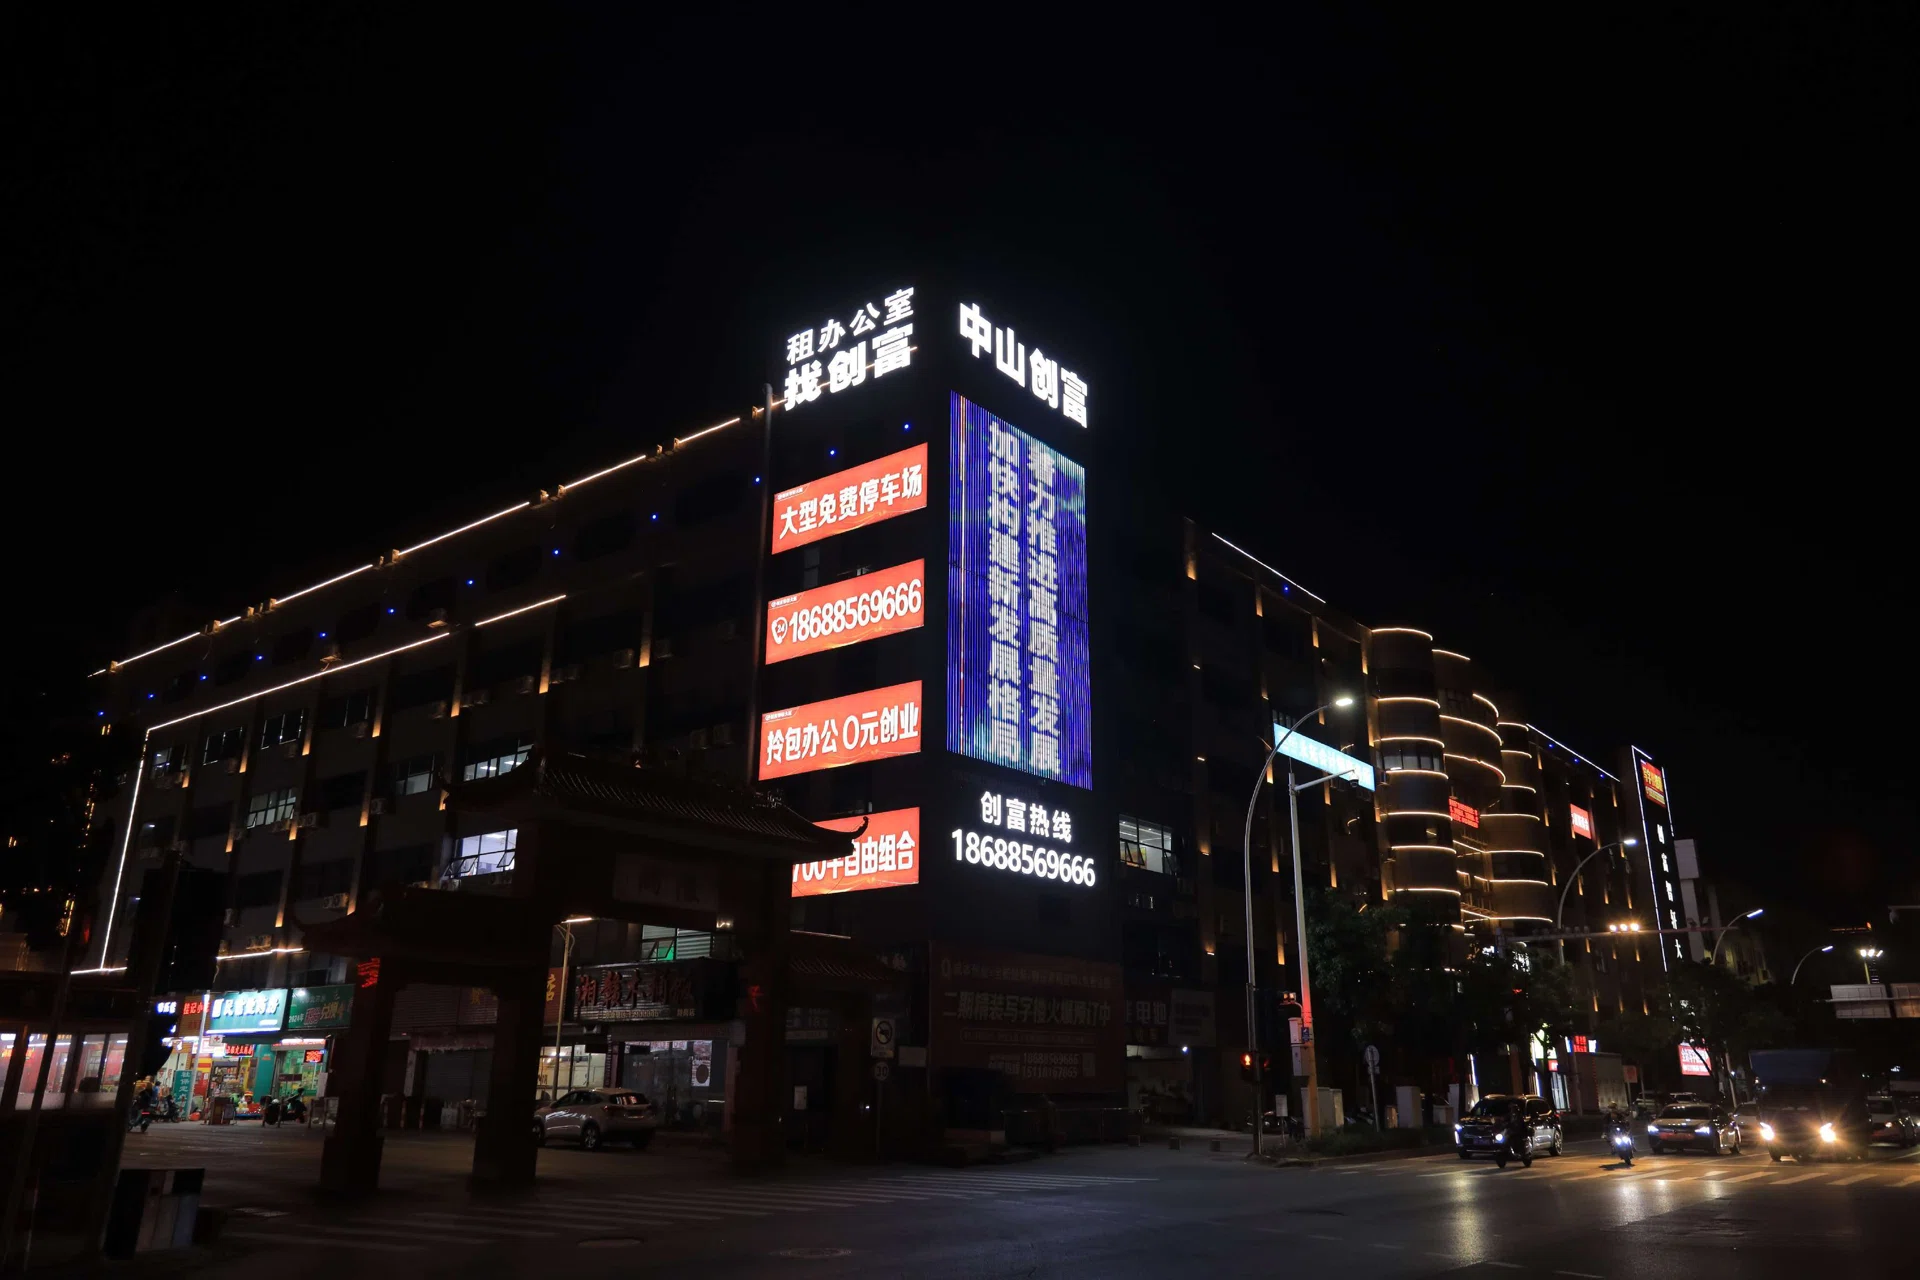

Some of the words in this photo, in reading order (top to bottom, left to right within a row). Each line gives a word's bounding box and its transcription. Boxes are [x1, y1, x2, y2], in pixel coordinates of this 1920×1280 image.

[787, 287, 914, 365] 租办公室
[960, 302, 1088, 428] 中山创富
[784, 323, 914, 411] 找创富
[779, 464, 922, 540] 大型免费停车场
[788, 578, 922, 645] 18688569666
[987, 420, 1021, 763] 加快构建新发展格局
[1027, 442, 1060, 775] 着力推进高质量发展
[980, 791, 1073, 843] 创富热线
[951, 829, 1097, 887] 18688569666
